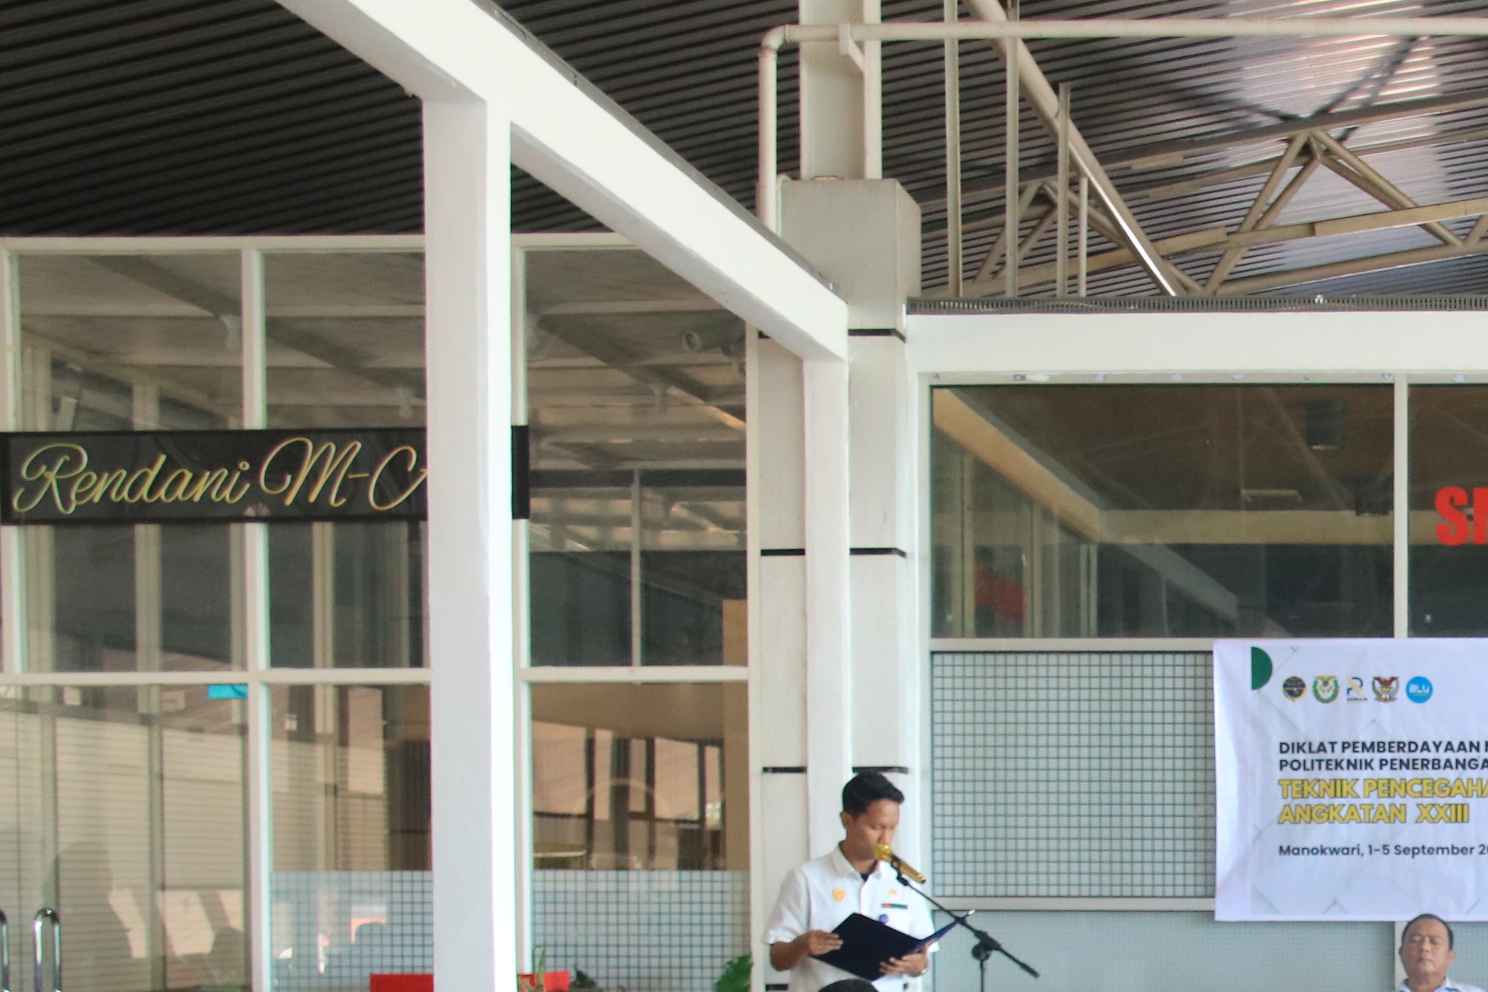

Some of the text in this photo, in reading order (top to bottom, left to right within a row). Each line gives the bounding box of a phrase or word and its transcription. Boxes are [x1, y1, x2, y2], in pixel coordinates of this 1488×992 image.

[13, 437, 427, 514] Rendani M-C
[1279, 742, 1338, 754] DIKLAT
[1342, 741, 1481, 753] PEMBERDAYAAN
[1279, 759, 1375, 771] POLITEKNIK
[1278, 777, 1360, 798] TEKNIK
[1278, 803, 1470, 824] ANGKATAN XXIII
[1279, 843, 1364, 857] Manokwari,
[1368, 844, 1390, 856] 1-5
[1394, 844, 1475, 859] September
